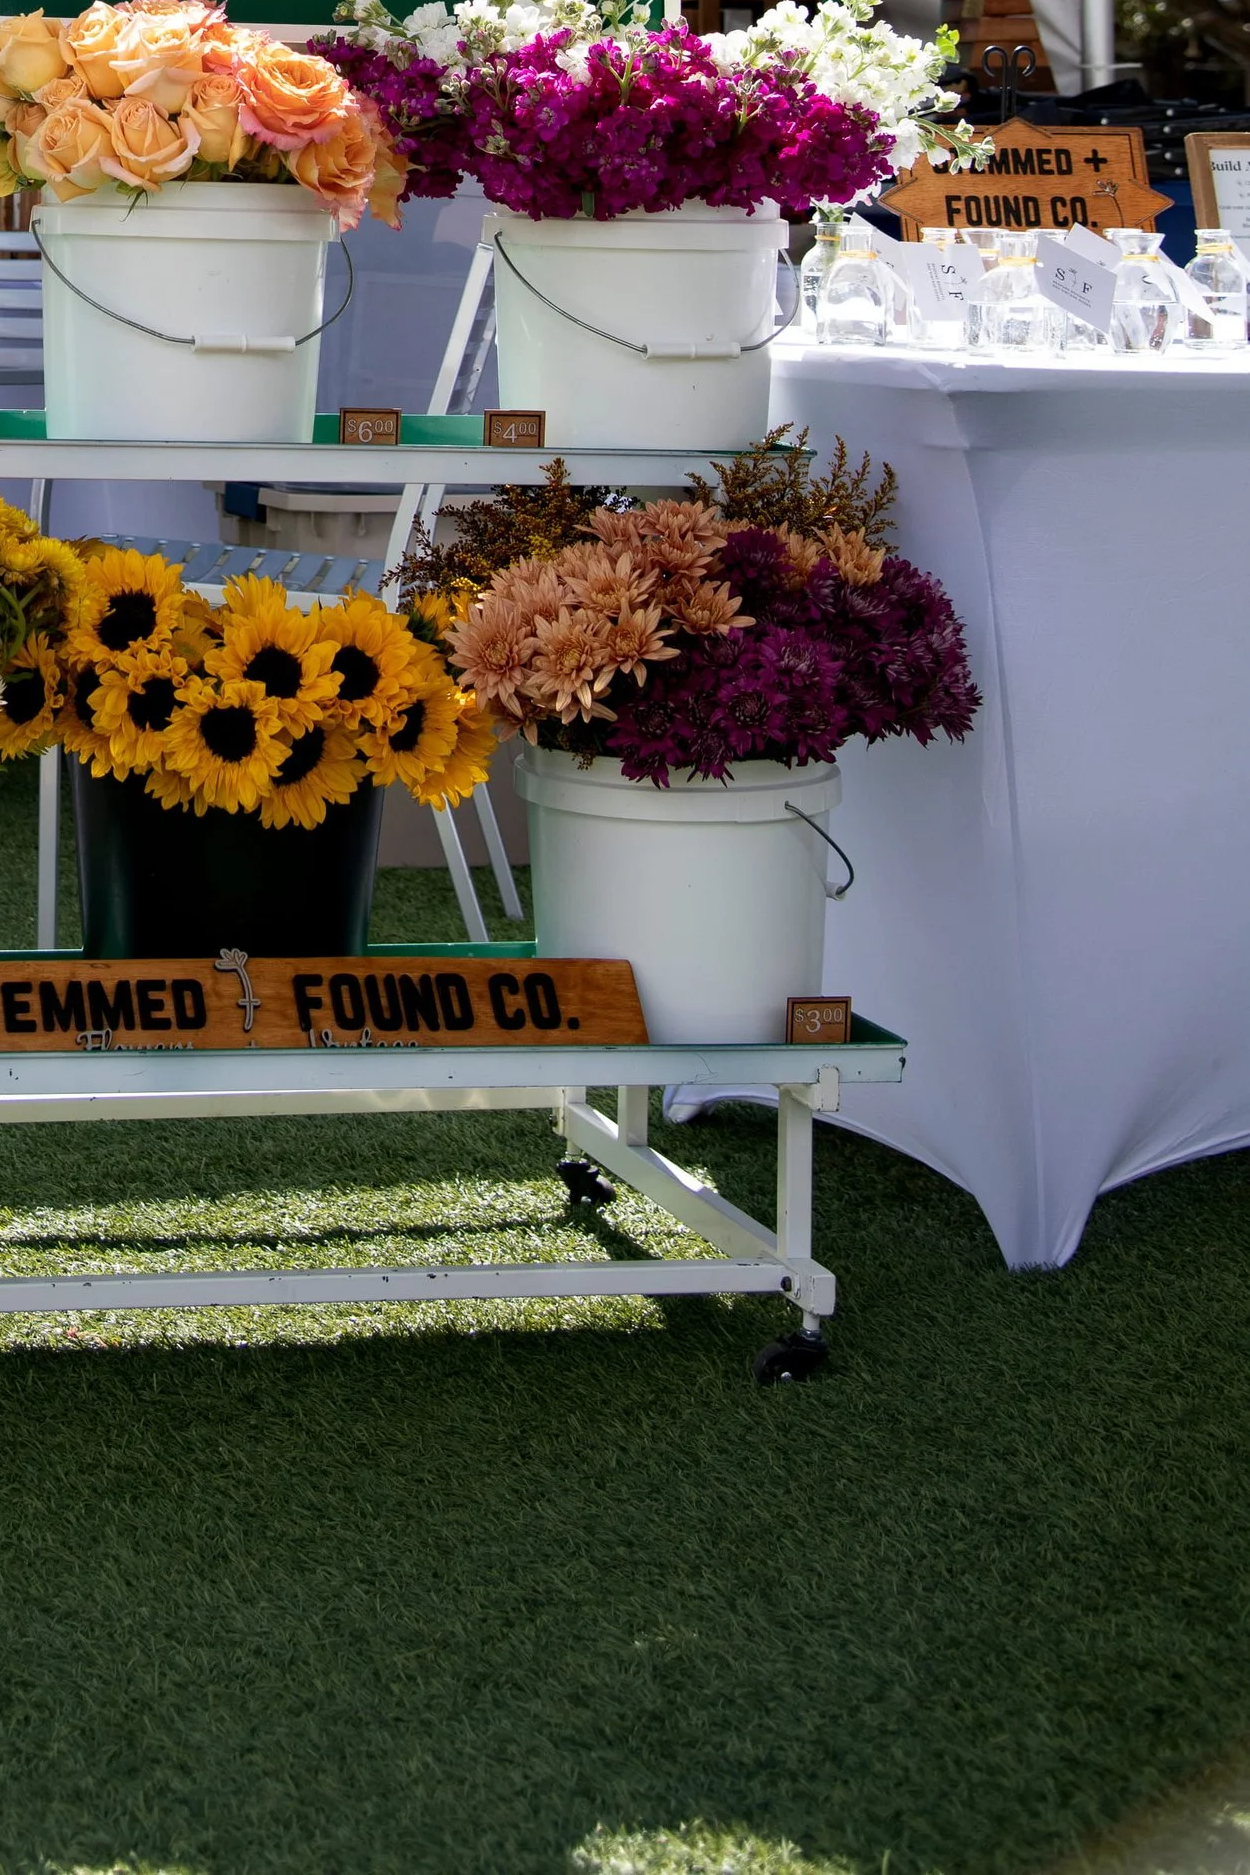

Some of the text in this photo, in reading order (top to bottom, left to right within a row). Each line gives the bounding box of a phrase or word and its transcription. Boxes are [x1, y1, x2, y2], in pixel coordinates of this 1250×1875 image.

[945, 195, 1098, 228] FOUND CO.
[292, 973, 474, 1032] FOUND
[488, 973, 579, 1030] CO.
